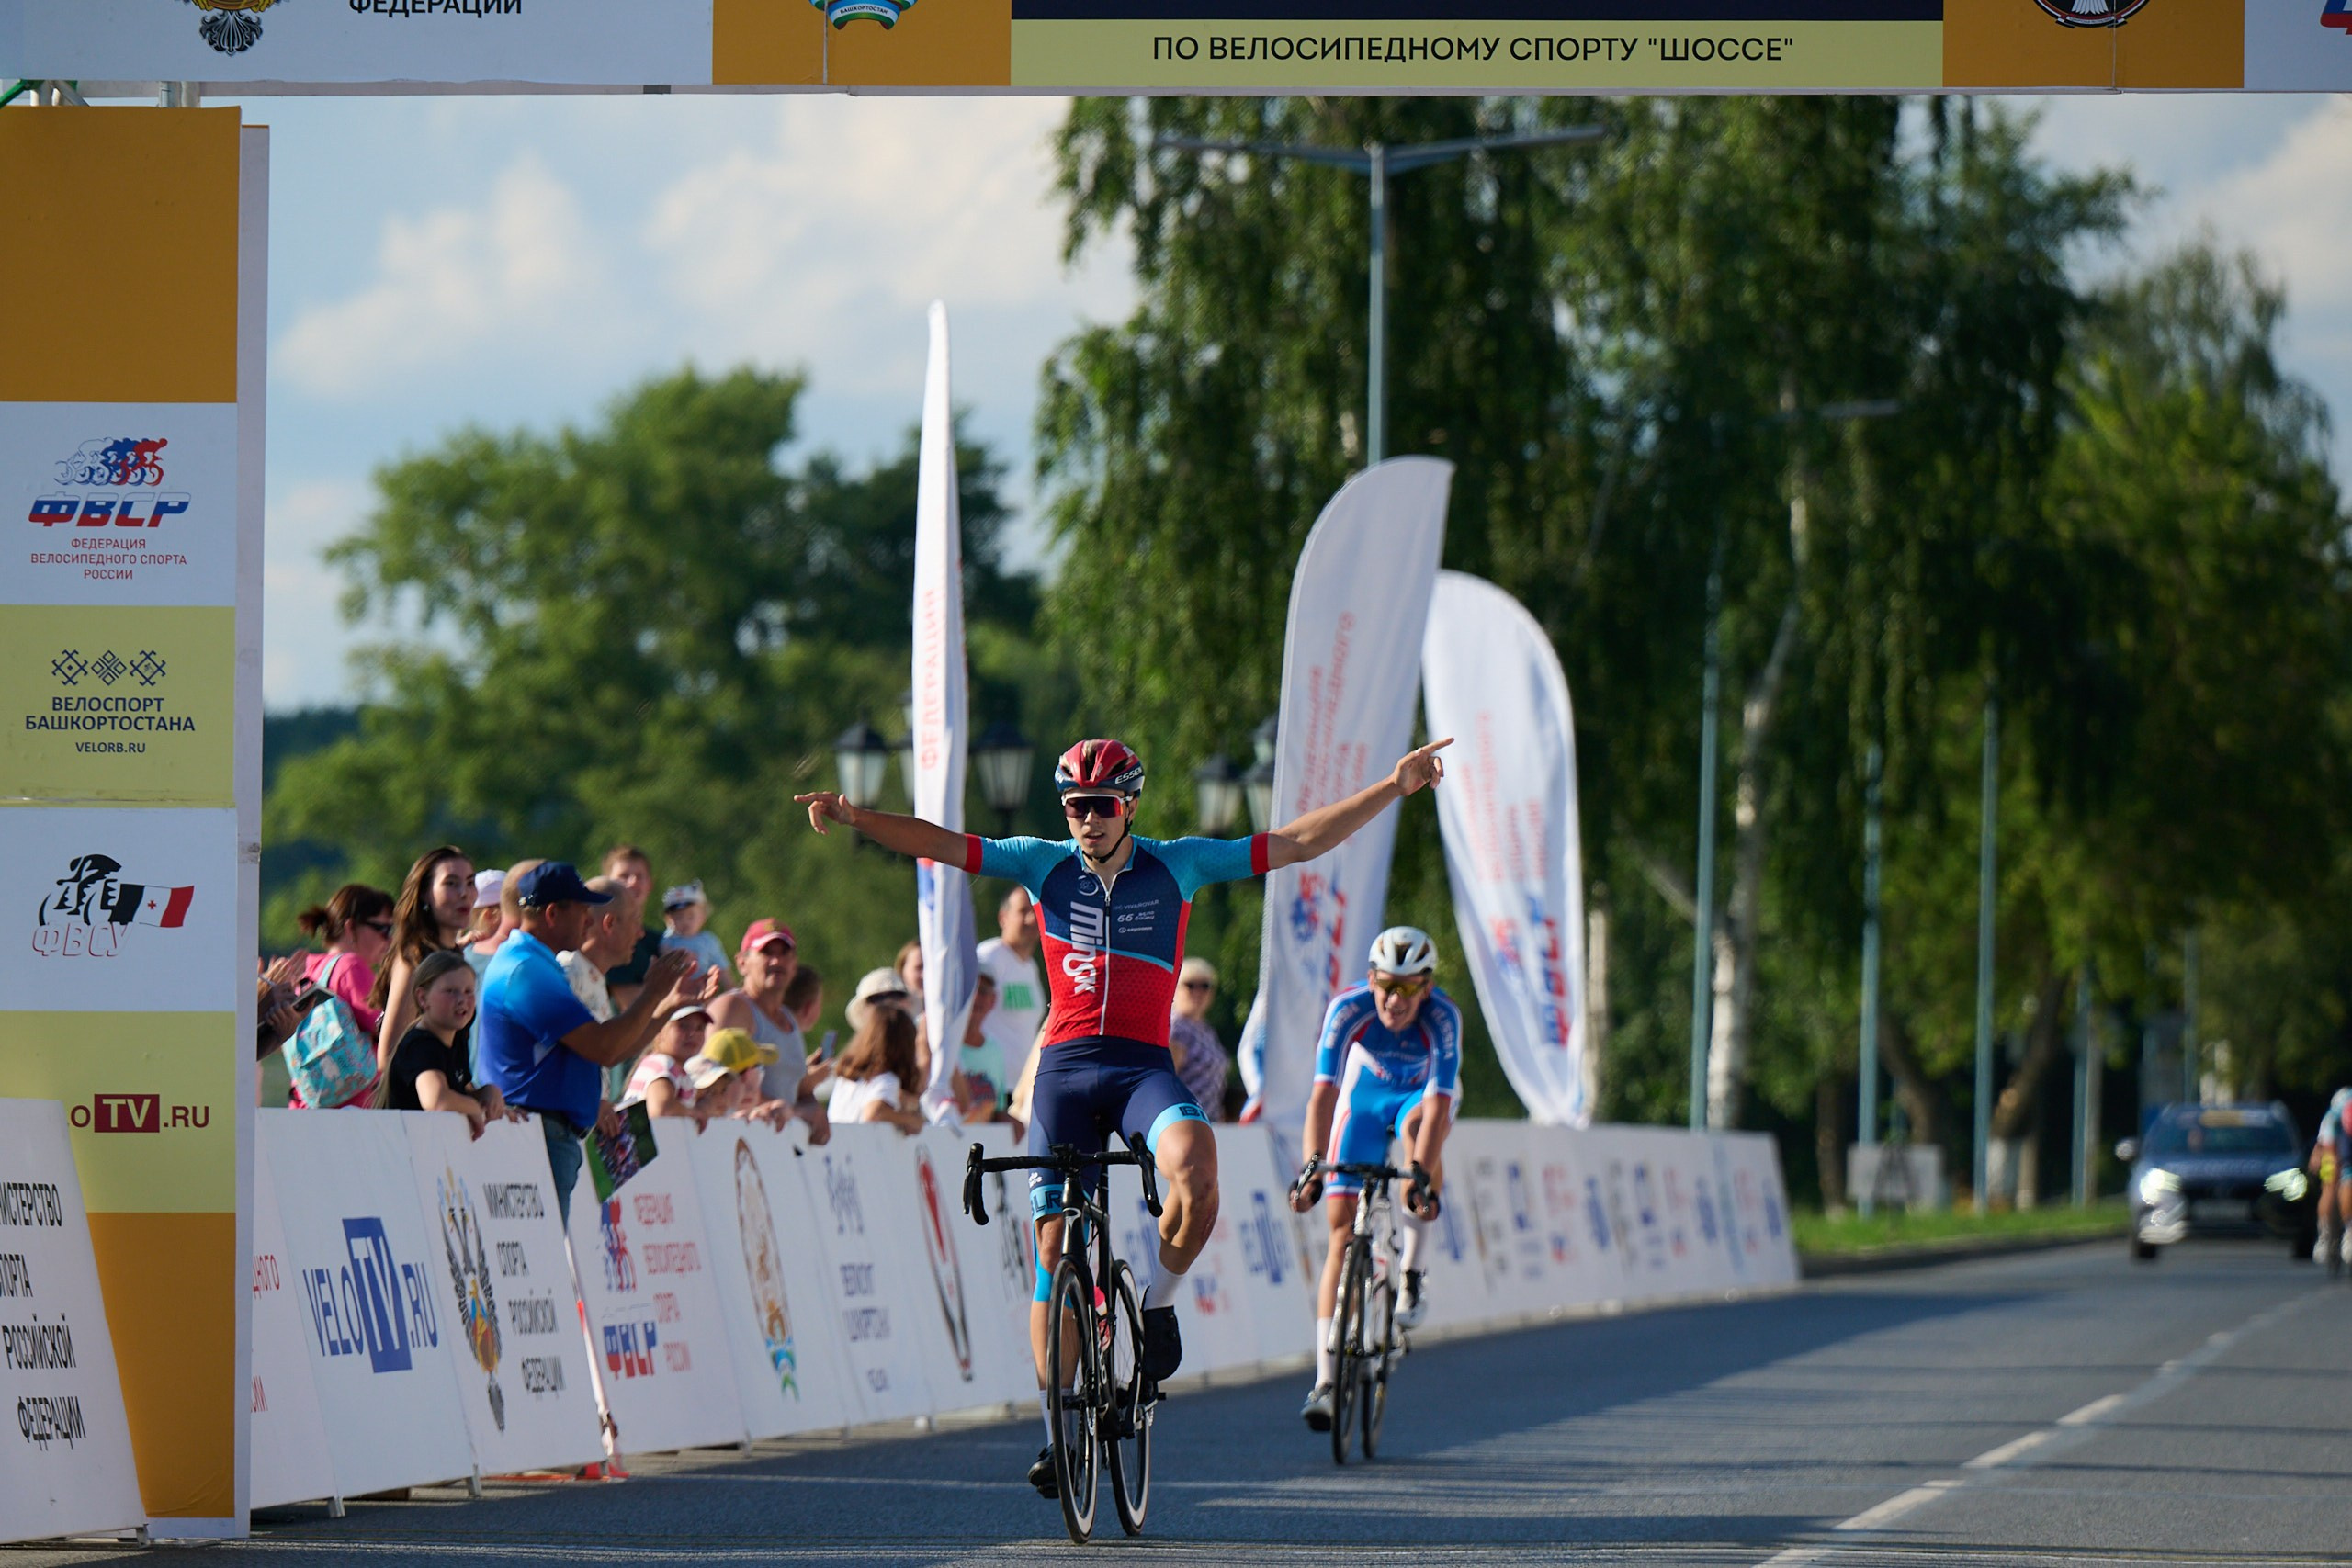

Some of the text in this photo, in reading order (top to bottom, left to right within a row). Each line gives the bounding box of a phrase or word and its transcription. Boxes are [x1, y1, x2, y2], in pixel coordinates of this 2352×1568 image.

[349, 0, 522, 18] ФЕДЕРАЦИИ
[1154, 37, 1793, 62] ПО ВЕЛОСИПЕДНОМУ СПОРТУ "ШОССЕ"
[28, 491, 191, 527] ФВСР
[71, 538, 146, 550] ФЕДЕРАЦИЯ
[30, 553, 187, 566] ВЕЛОСИПЕДНОГО СПОРТА
[84, 569, 133, 580] РОССИИ
[51, 696, 164, 712] ВЕЛОСПОРТ
[26, 716, 196, 731] БАШКОРТОСТАНА
[75, 742, 146, 753] VELORB.RU
[70, 1098, 210, 1129] OTV.RU
[0, 1181, 62, 1227] ИСТЕРСТВО
[0, 1253, 33, 1298] ПОРТА
[2, 1312, 77, 1370] РОССИЙСКОЙ
[17, 1395, 86, 1451] ФЕДЕРАЦИИ
